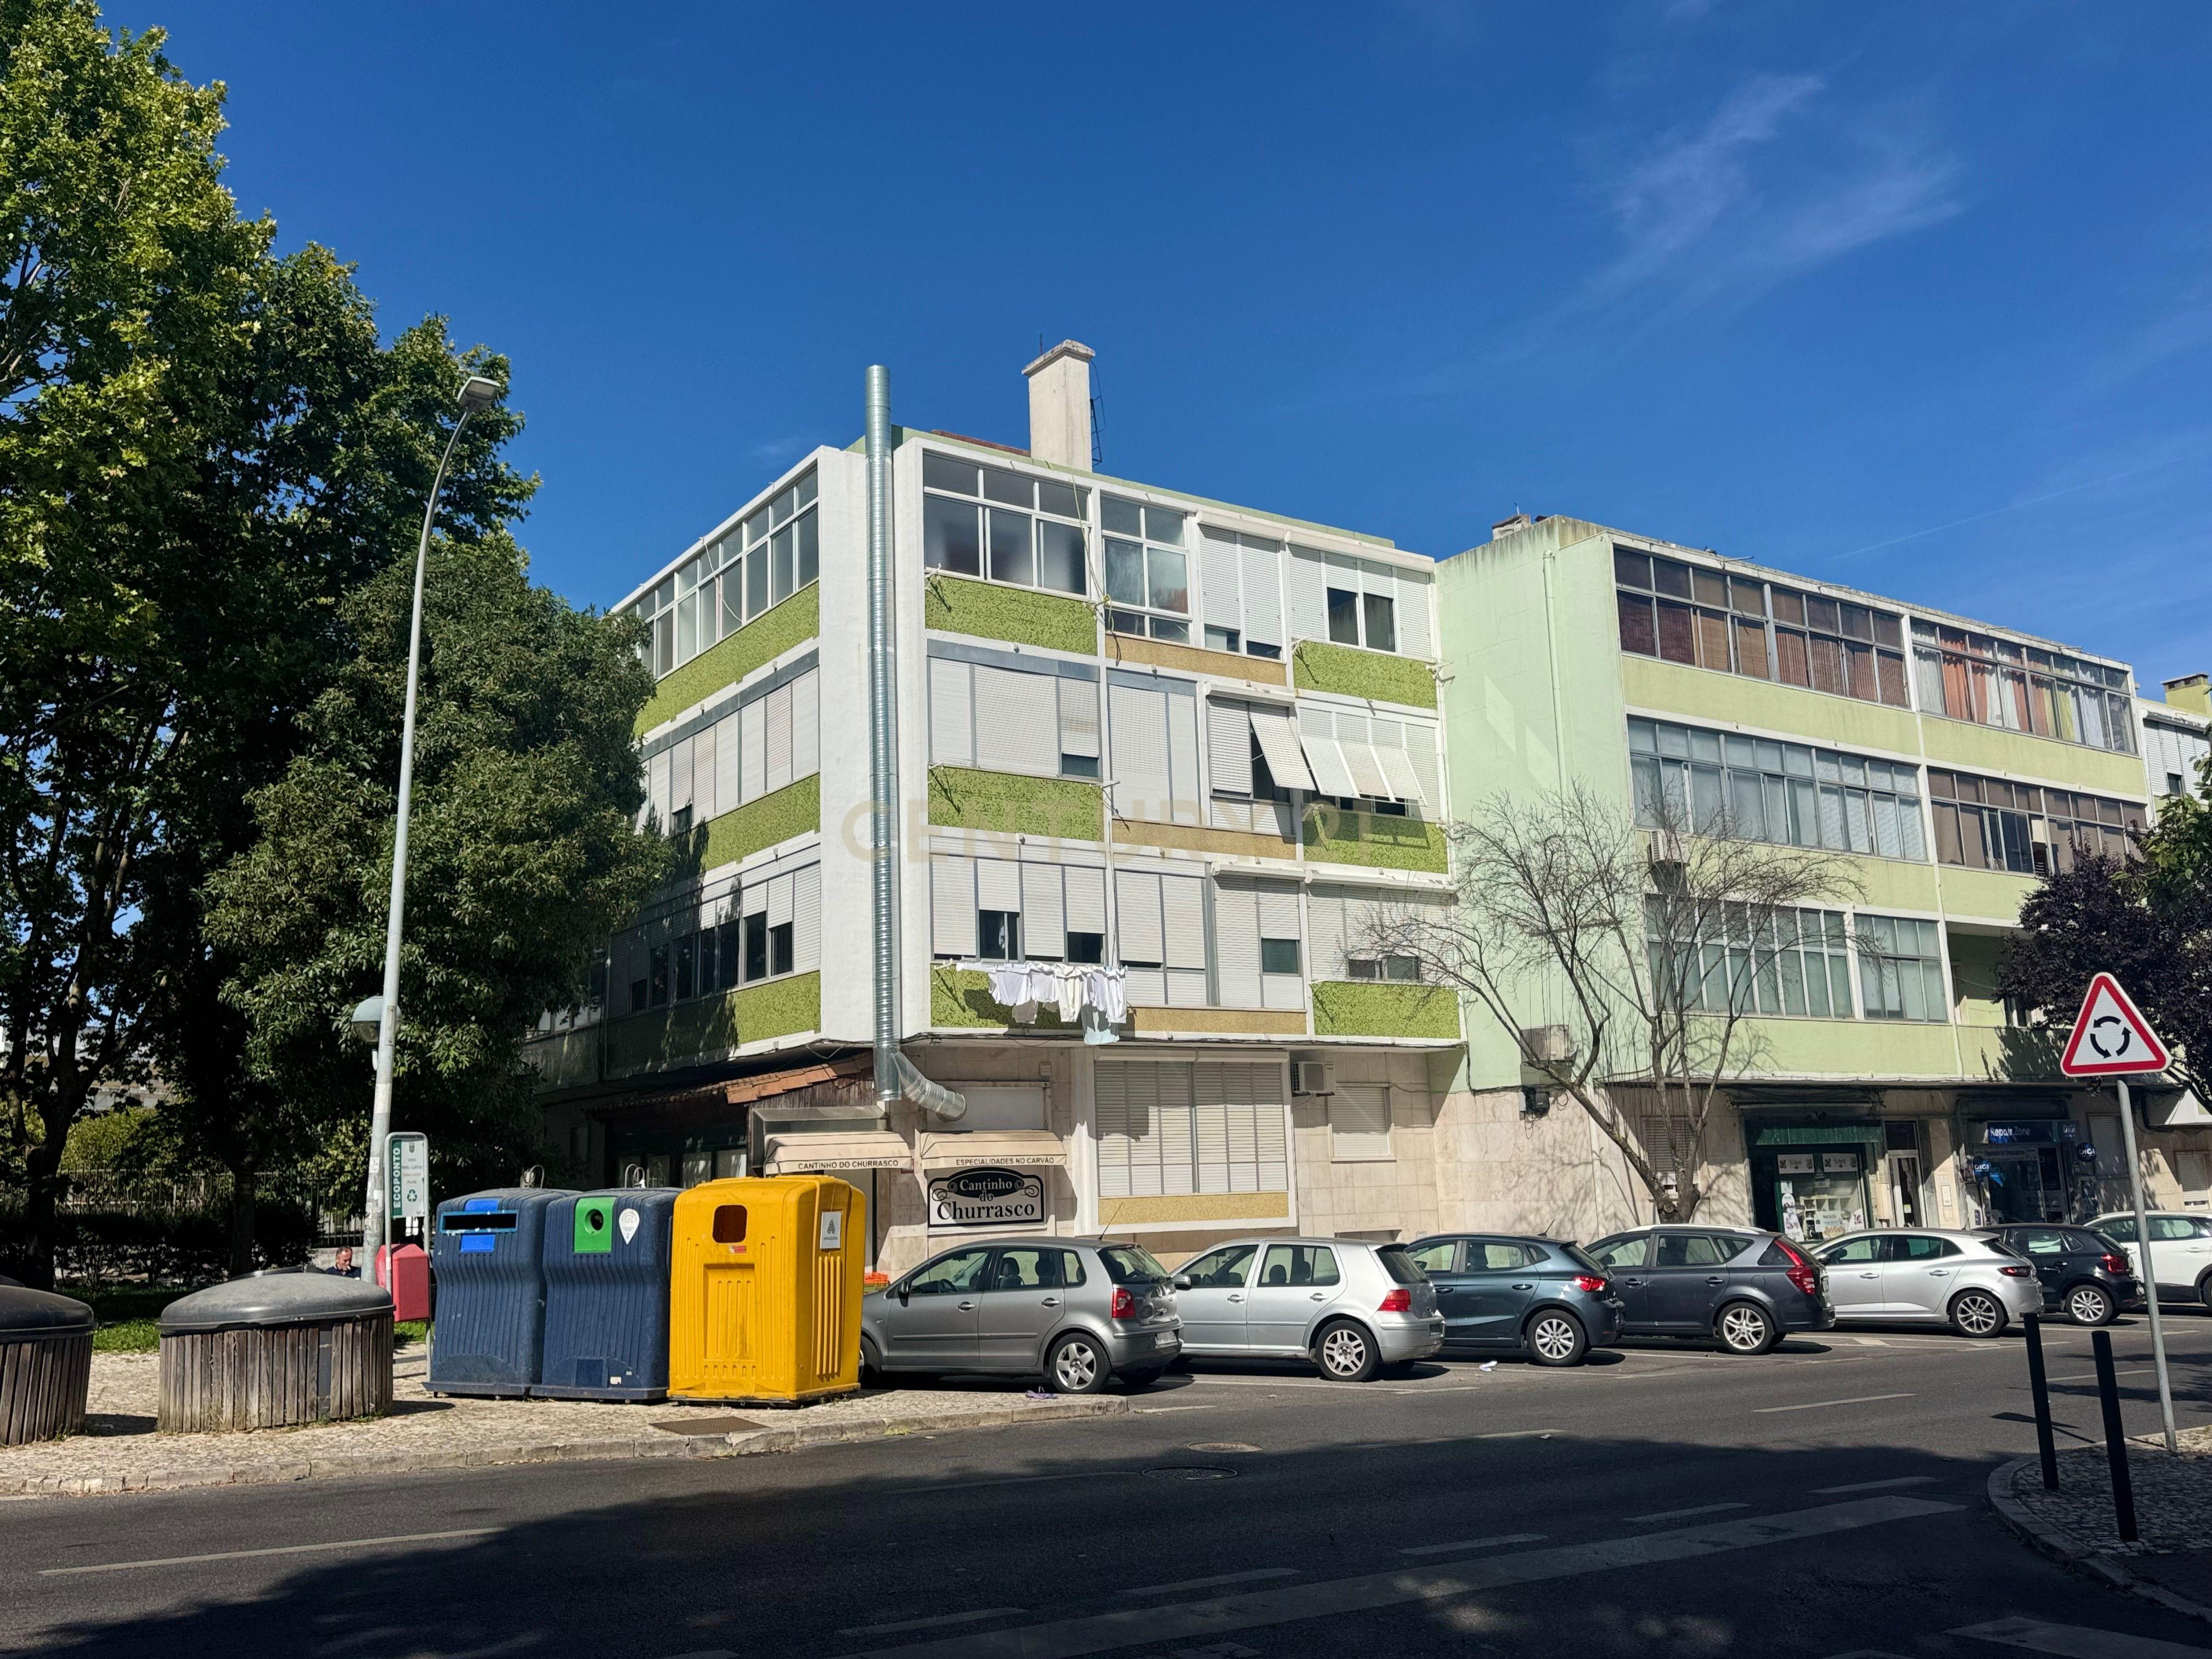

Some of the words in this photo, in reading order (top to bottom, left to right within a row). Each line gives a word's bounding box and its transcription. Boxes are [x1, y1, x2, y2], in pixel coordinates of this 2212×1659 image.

[1990, 1127, 2013, 1139] Repair
[2015, 1127, 2031, 1136] Zone
[2063, 1124, 2076, 1133] DIGI
[798, 1161, 837, 1170] CANTINHO
[956, 1158, 1014, 1166] ESPECIALIDADES
[393, 1147, 401, 1208] ECOPONTO
[960, 1178, 1013, 1191] Cantinho
[979, 1190, 994, 1202] do
[937, 1201, 1035, 1220] Churrasco
